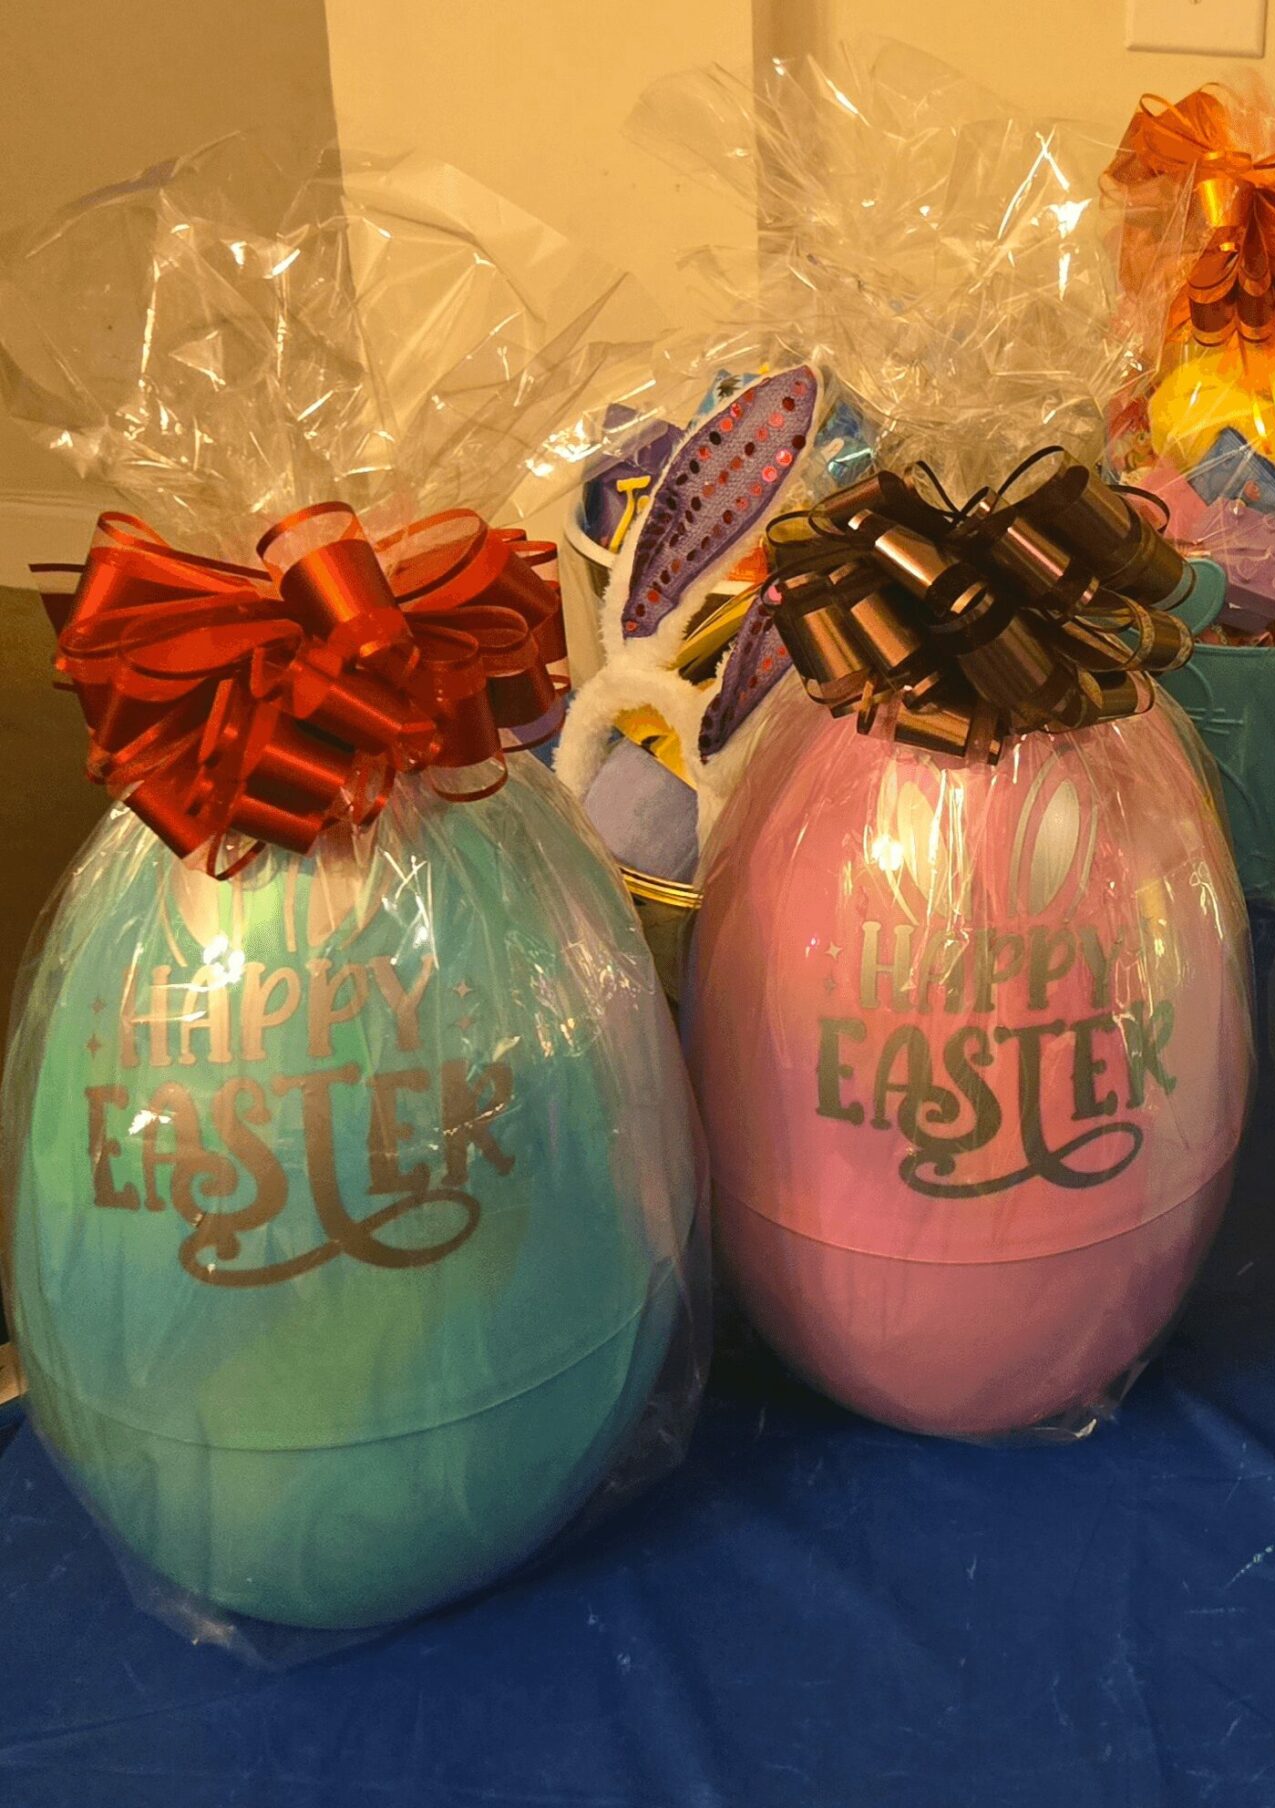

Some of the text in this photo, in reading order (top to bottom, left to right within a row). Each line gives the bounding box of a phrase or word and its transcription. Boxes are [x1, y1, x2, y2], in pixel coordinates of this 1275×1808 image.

[120, 955, 435, 1068] HAPPY
[860, 921, 1124, 1015] HAPPY
[85, 1060, 516, 1287] EASTER
[816, 1001, 1178, 1198] EASTER
